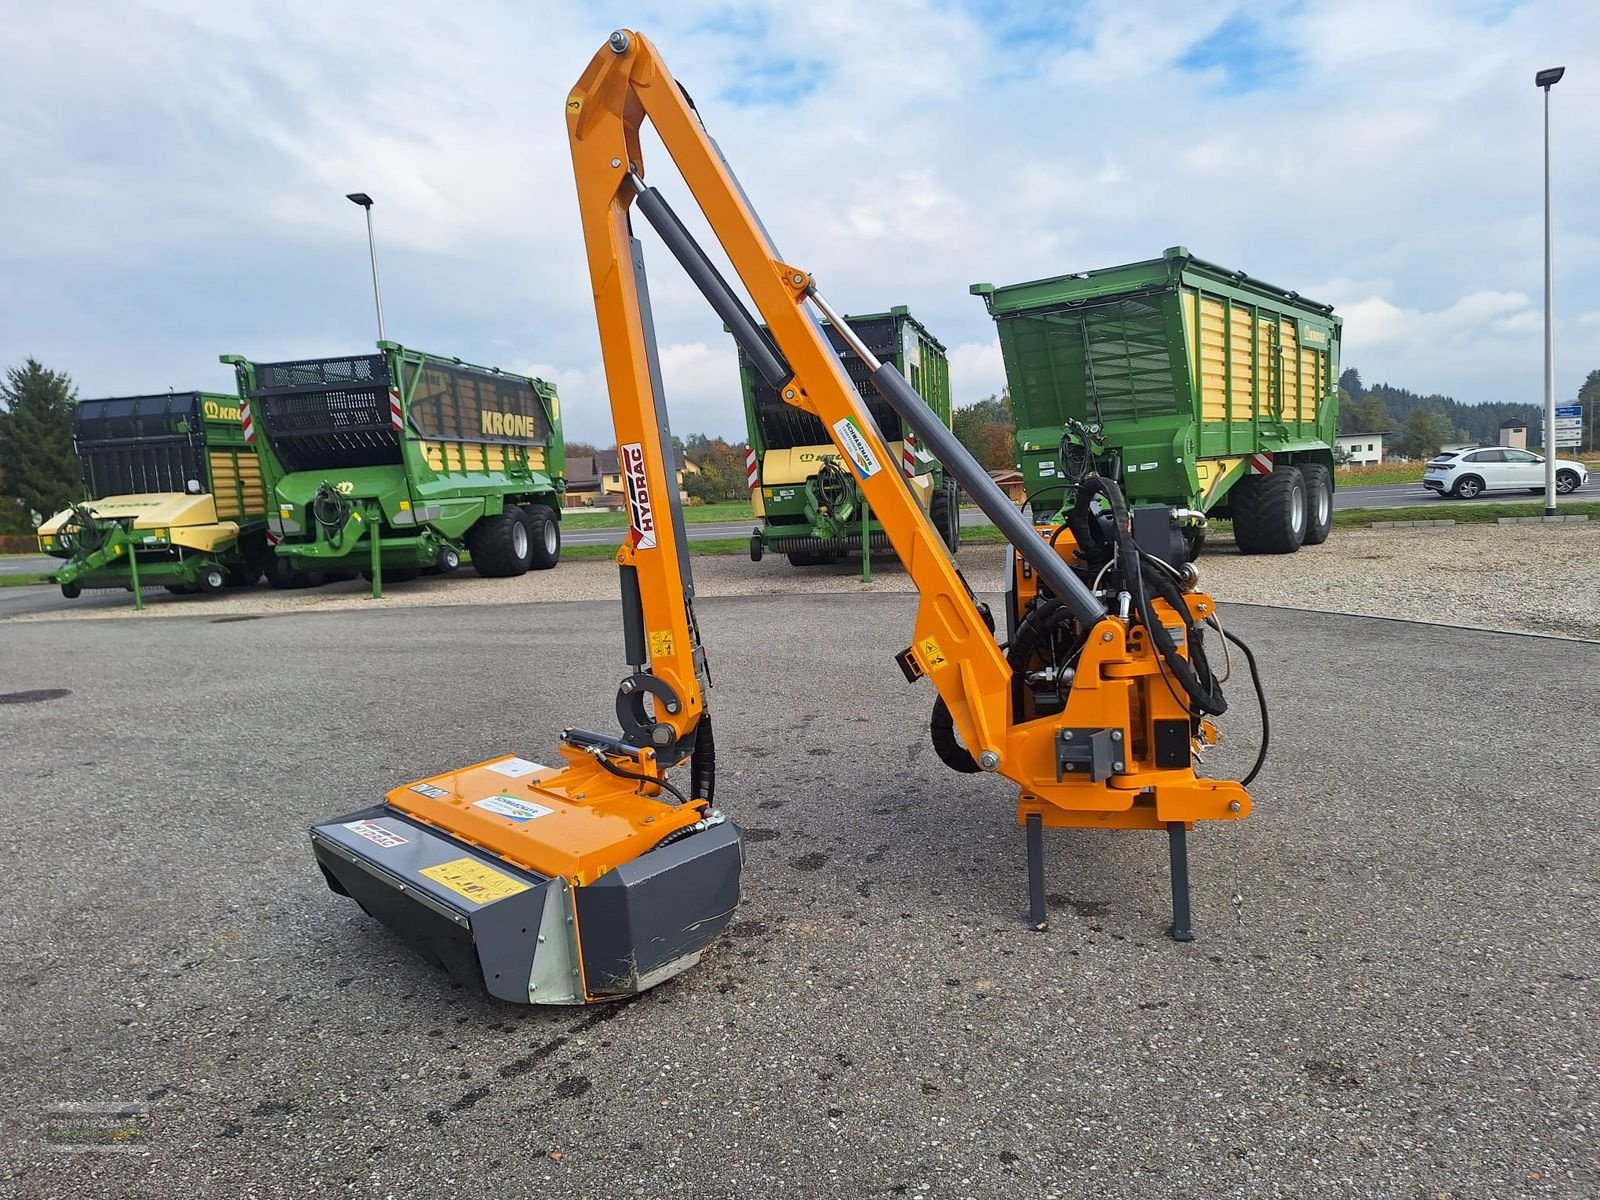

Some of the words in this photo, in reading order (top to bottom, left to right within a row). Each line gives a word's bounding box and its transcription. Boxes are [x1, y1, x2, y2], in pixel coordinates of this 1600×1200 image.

[220, 407, 241, 420] KRO
[482, 410, 534, 438] KRONE
[846, 423, 873, 466] SCHWARZMAYR
[632, 448, 653, 532] HYDRAC
[352, 824, 395, 846] HYDRAC
